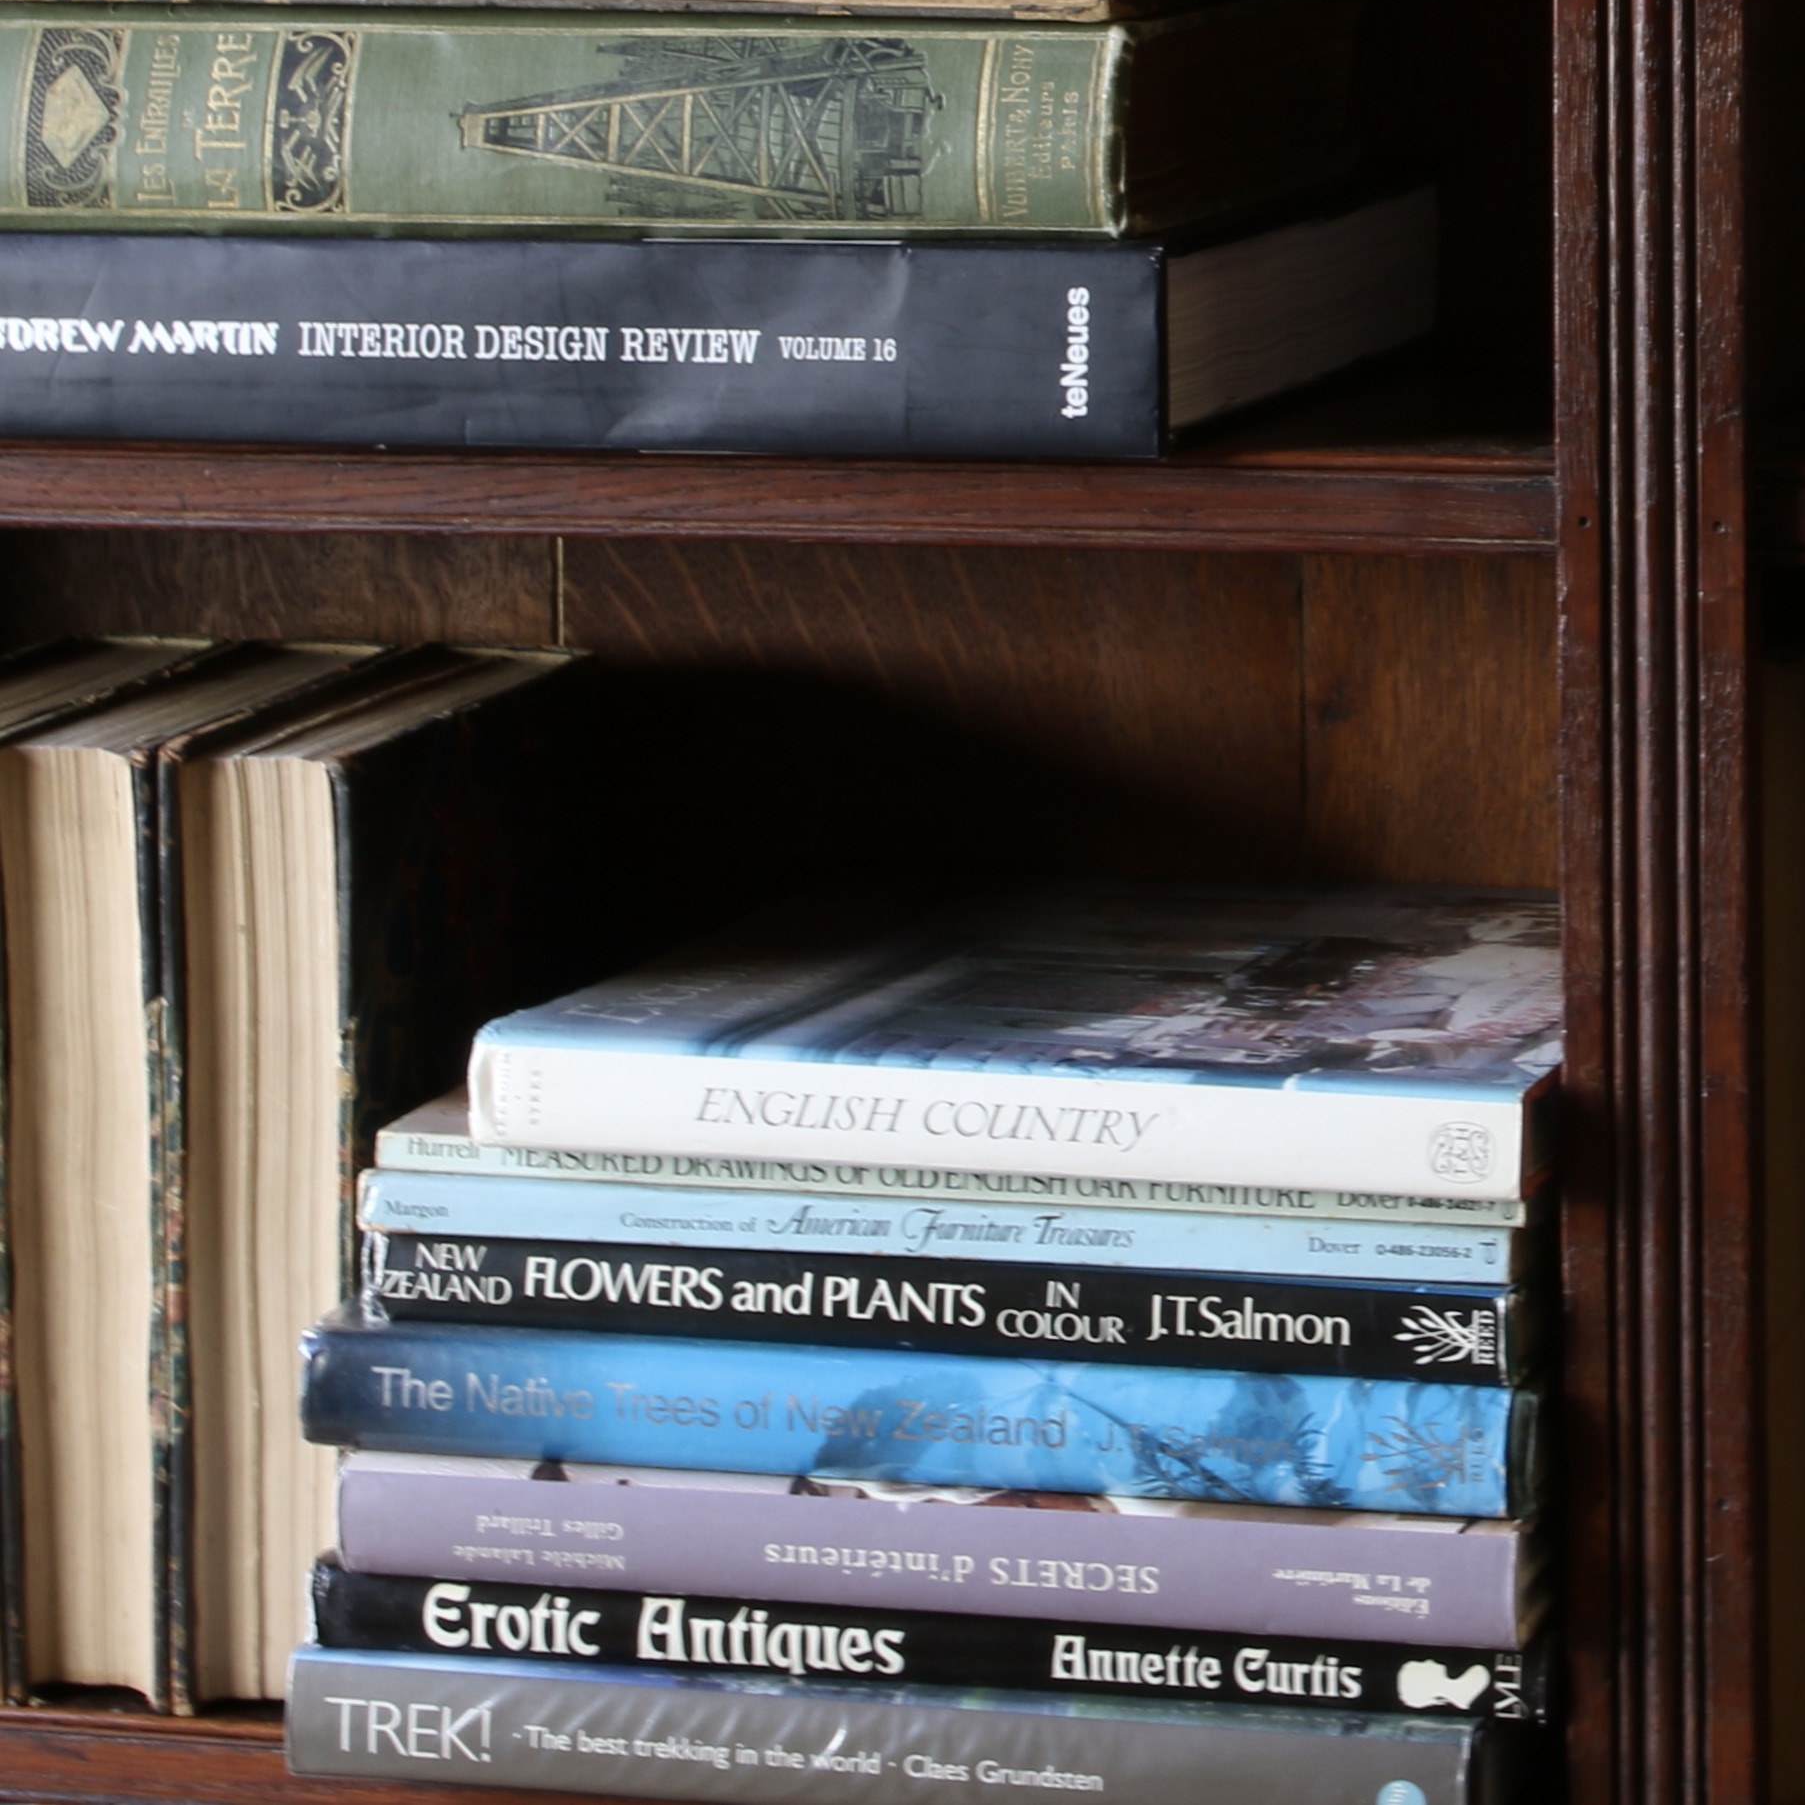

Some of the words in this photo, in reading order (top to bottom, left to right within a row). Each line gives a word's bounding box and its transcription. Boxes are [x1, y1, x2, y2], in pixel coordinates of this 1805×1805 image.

[134, 33, 181, 158] ENTRAILLES
[193, 31, 255, 161] TERRE
[1060, 89, 1080, 172] PARIS
[128, 319, 281, 357] MARTIN
[298, 321, 468, 360] INTERIOR
[475, 324, 609, 363] DESIGN
[620, 327, 762, 365] REVIEW
[778, 335, 867, 362] VOLUME
[872, 337, 898, 363] 16
[1060, 286, 1091, 420] teNeues
[693, 1086, 907, 1133] ENGLISH
[922, 1099, 1163, 1153] COUNTRY
[405, 1136, 481, 1161] Hurrell
[501, 1148, 663, 1176] MEASURED
[671, 1153, 828, 1184] DRAWINGS
[878, 1166, 940, 1190] OLD
[945, 1171, 1067, 1196] ENGLISH
[1075, 1177, 1137, 1199] OAK
[1149, 1181, 1315, 1209] FURNITURE
[1336, 1192, 1401, 1209] Dover
[383, 1199, 450, 1219] Margon
[619, 1212, 735, 1234] Construction
[765, 1204, 892, 1239] American
[901, 1207, 1029, 1253] Furniture
[1030, 1211, 1136, 1248] Treasures
[1307, 1236, 1362, 1256] Dover
[1375, 1244, 1473, 1260] 0-486-23056-2
[414, 1241, 488, 1273] NEW
[381, 1269, 514, 1306] ZEALAND
[523, 1255, 726, 1312] FLOWERS
[730, 1271, 815, 1317] and
[821, 1275, 987, 1328] PLANTS
[1045, 1280, 1082, 1310] IN
[995, 1308, 1128, 1345] COLOUR
[371, 1365, 455, 1412] The
[465, 1371, 595, 1422] Native
[606, 1381, 722, 1429] Trees
[732, 1390, 774, 1432] of
[785, 1396, 884, 1440] New
[892, 1400, 1068, 1451] Zealand
[1163, 1425, 1295, 1464] Salmon
[475, 1514, 558, 1538] Trillard
[560, 1519, 625, 1542] Gilles
[452, 1544, 536, 1567] Lalande
[539, 1551, 626, 1571] Michèle
[764, 1539, 977, 1585] d'intérieurs
[990, 1557, 1160, 1595] SECRETS
[422, 1582, 602, 1656] Erotic
[635, 1596, 907, 1676] Antiques
[1050, 1634, 1222, 1691] Annette
[1233, 1647, 1364, 1699] Curtis
[1494, 1653, 1523, 1721] LYLE
[324, 1696, 493, 1765] TREK!
[525, 1724, 572, 1753] The
[577, 1729, 629, 1755] best
[632, 1734, 731, 1770] trekking
[737, 1742, 760, 1767] in
[764, 1744, 806, 1770] the
[810, 1748, 882, 1775] world
[904, 1754, 970, 1783] Claes
[976, 1760, 1104, 1793] Grundsten
